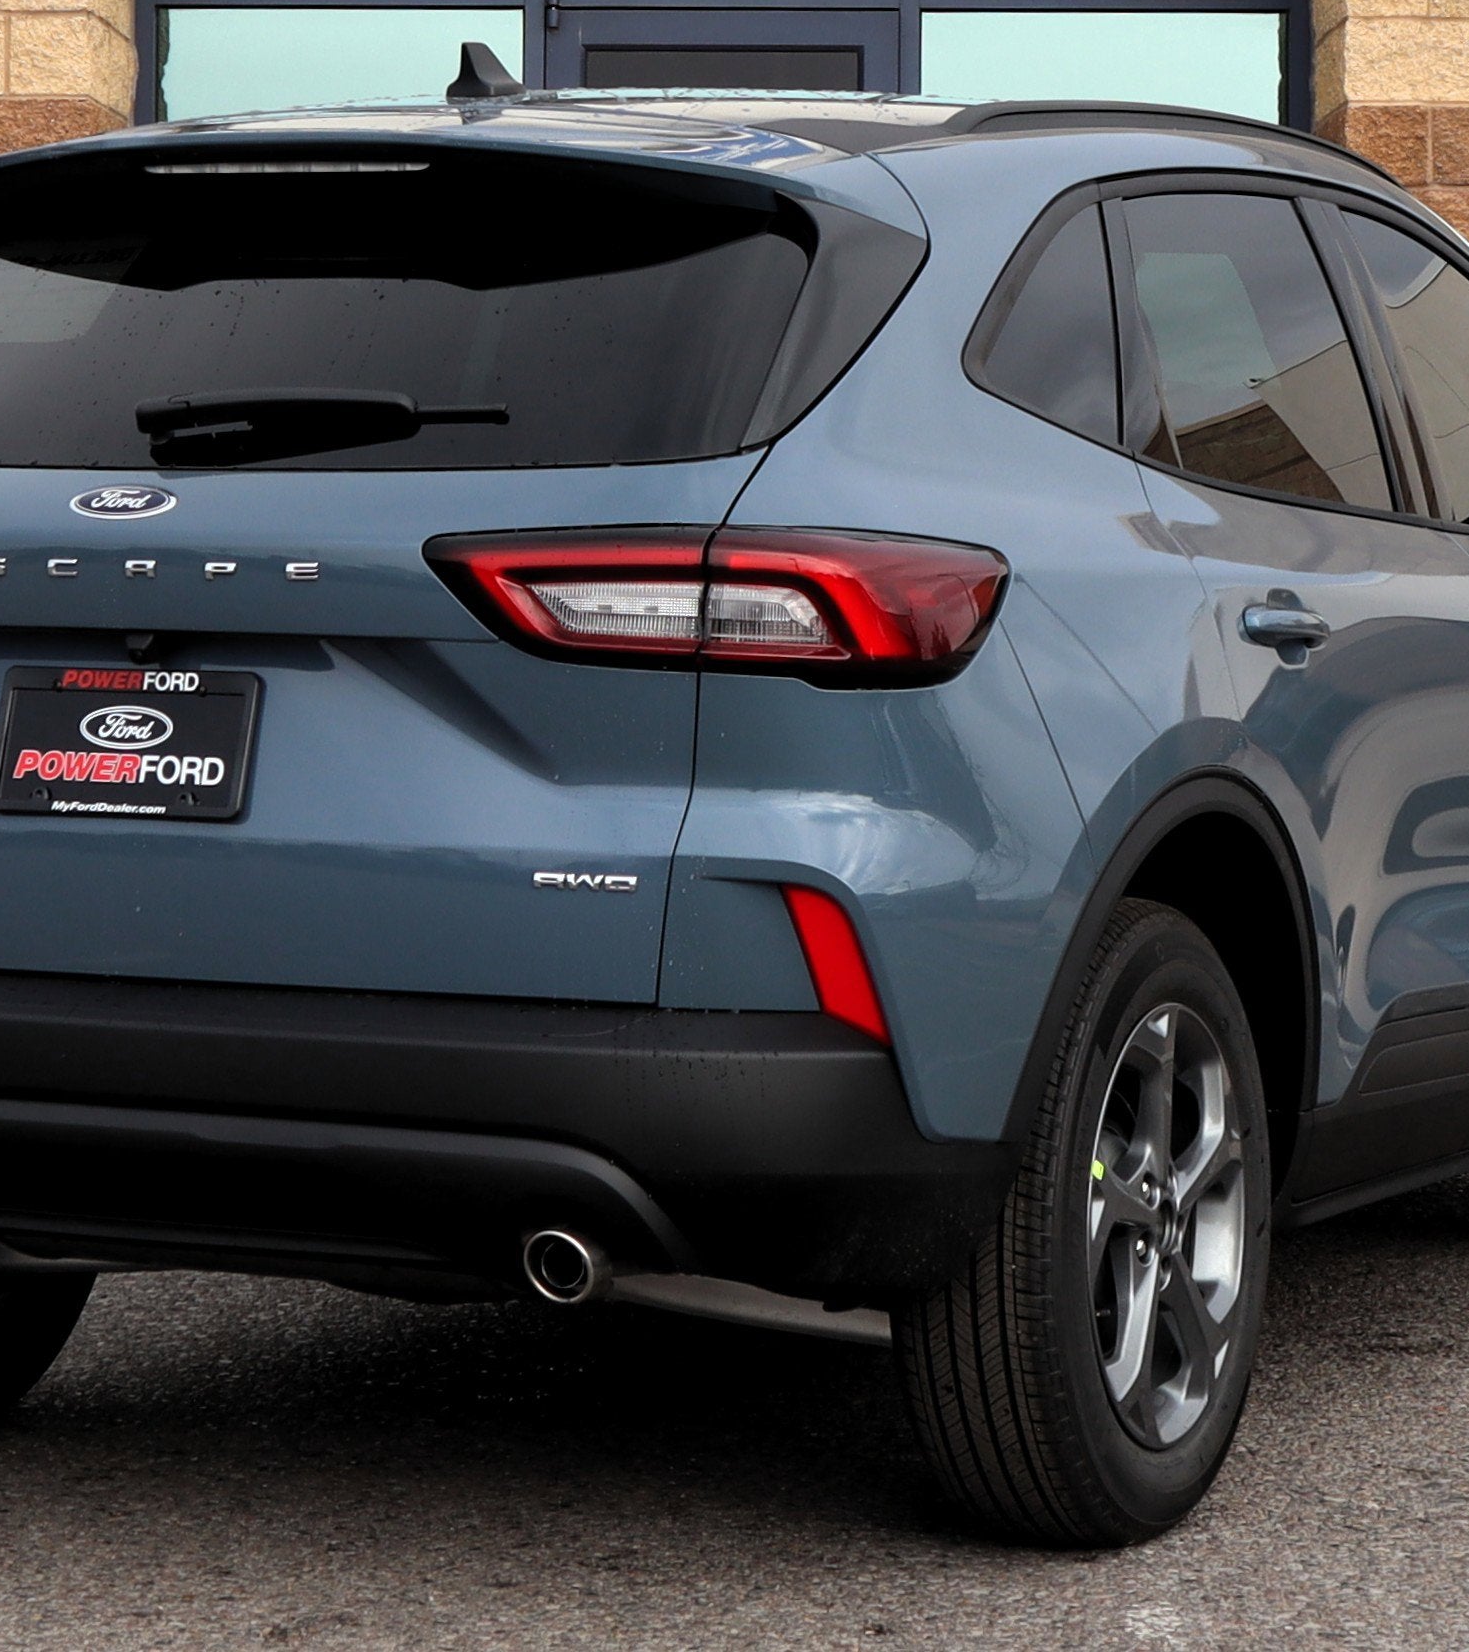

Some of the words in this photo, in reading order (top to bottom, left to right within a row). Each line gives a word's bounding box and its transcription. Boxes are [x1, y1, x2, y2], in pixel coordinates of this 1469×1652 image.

[90, 489, 148, 510] Ford
[61, 669, 200, 692] POWERFORD
[98, 713, 153, 740] Ford
[12, 749, 225, 786] POWERFORD
[50, 800, 167, 815] MyFordDealer.com
[533, 872, 638, 892] AWD
